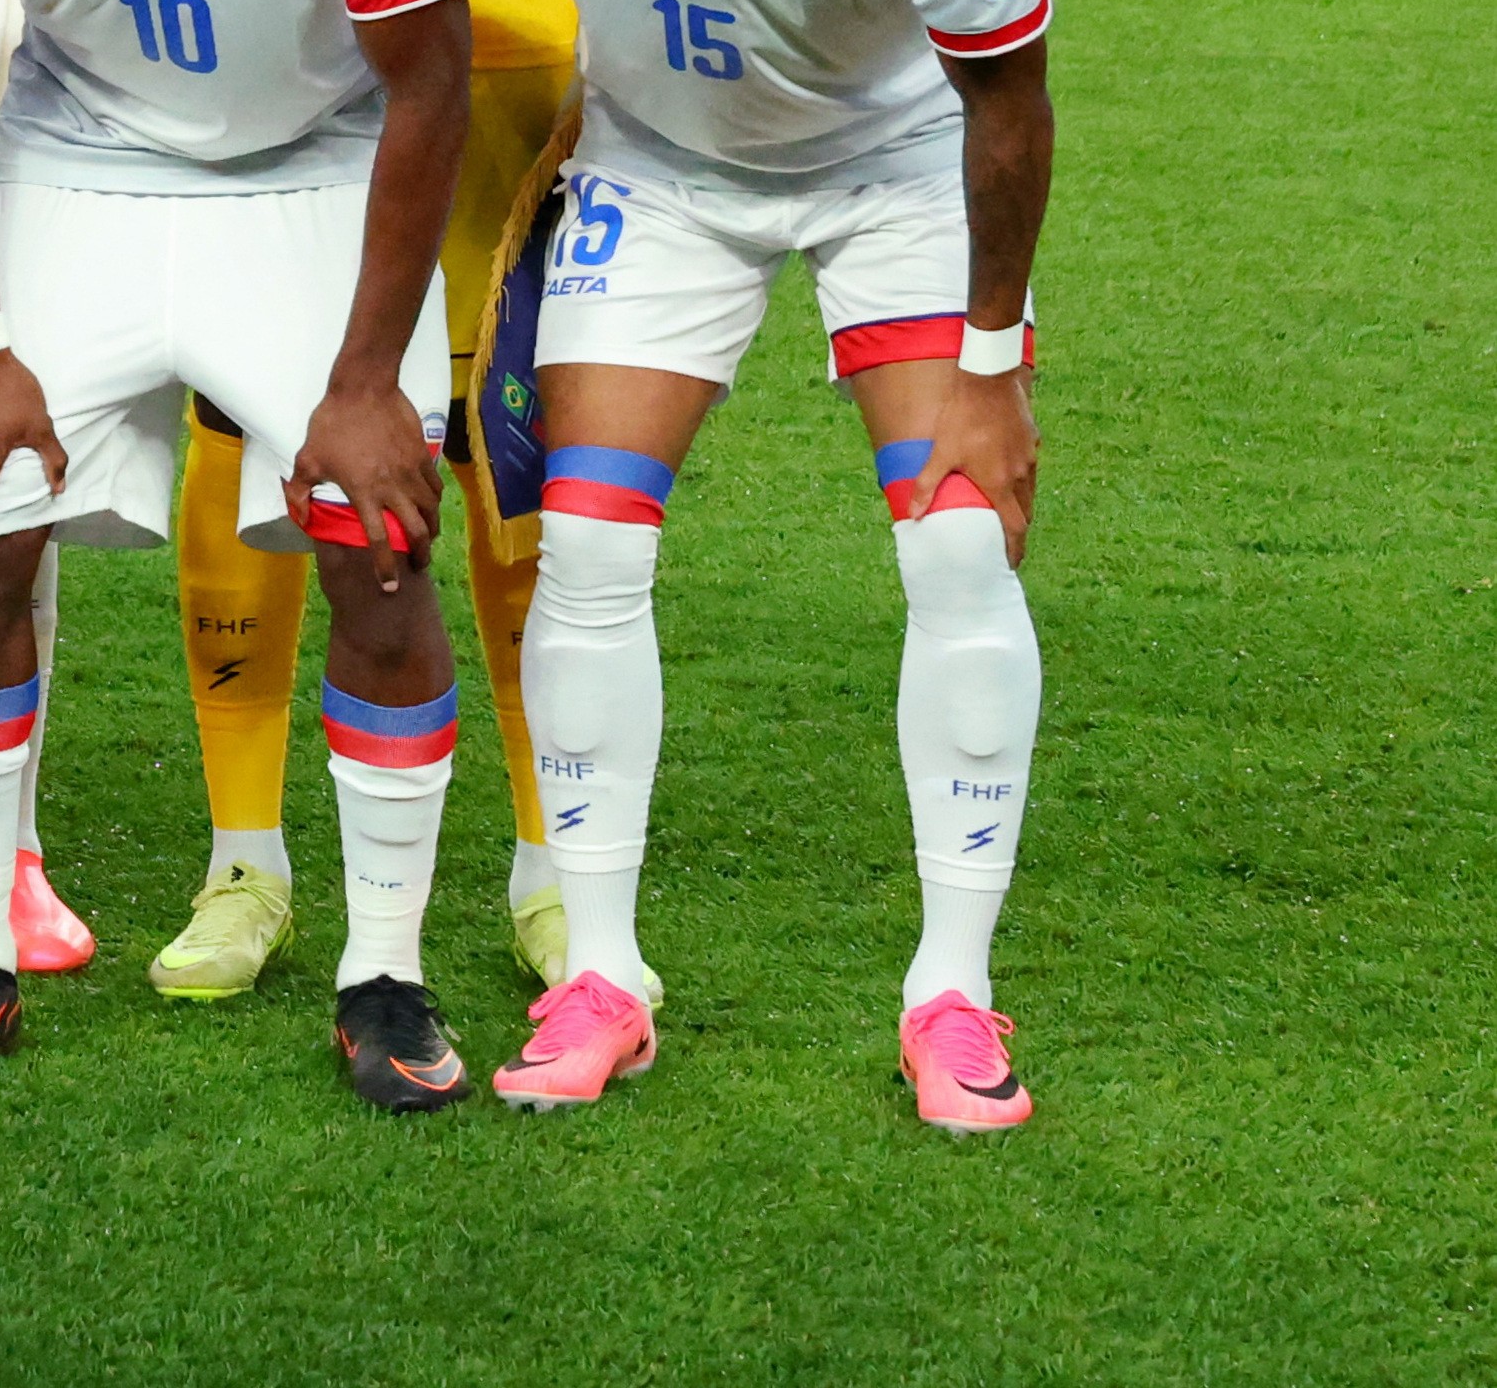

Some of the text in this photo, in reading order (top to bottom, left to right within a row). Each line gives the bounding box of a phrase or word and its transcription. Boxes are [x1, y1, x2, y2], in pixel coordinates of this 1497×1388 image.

[555, 173, 632, 268] 15
[543, 276, 607, 296] AETA
[197, 617, 258, 634] FHF
[541, 756, 594, 779] FHF
[952, 779, 1012, 801] FHF
